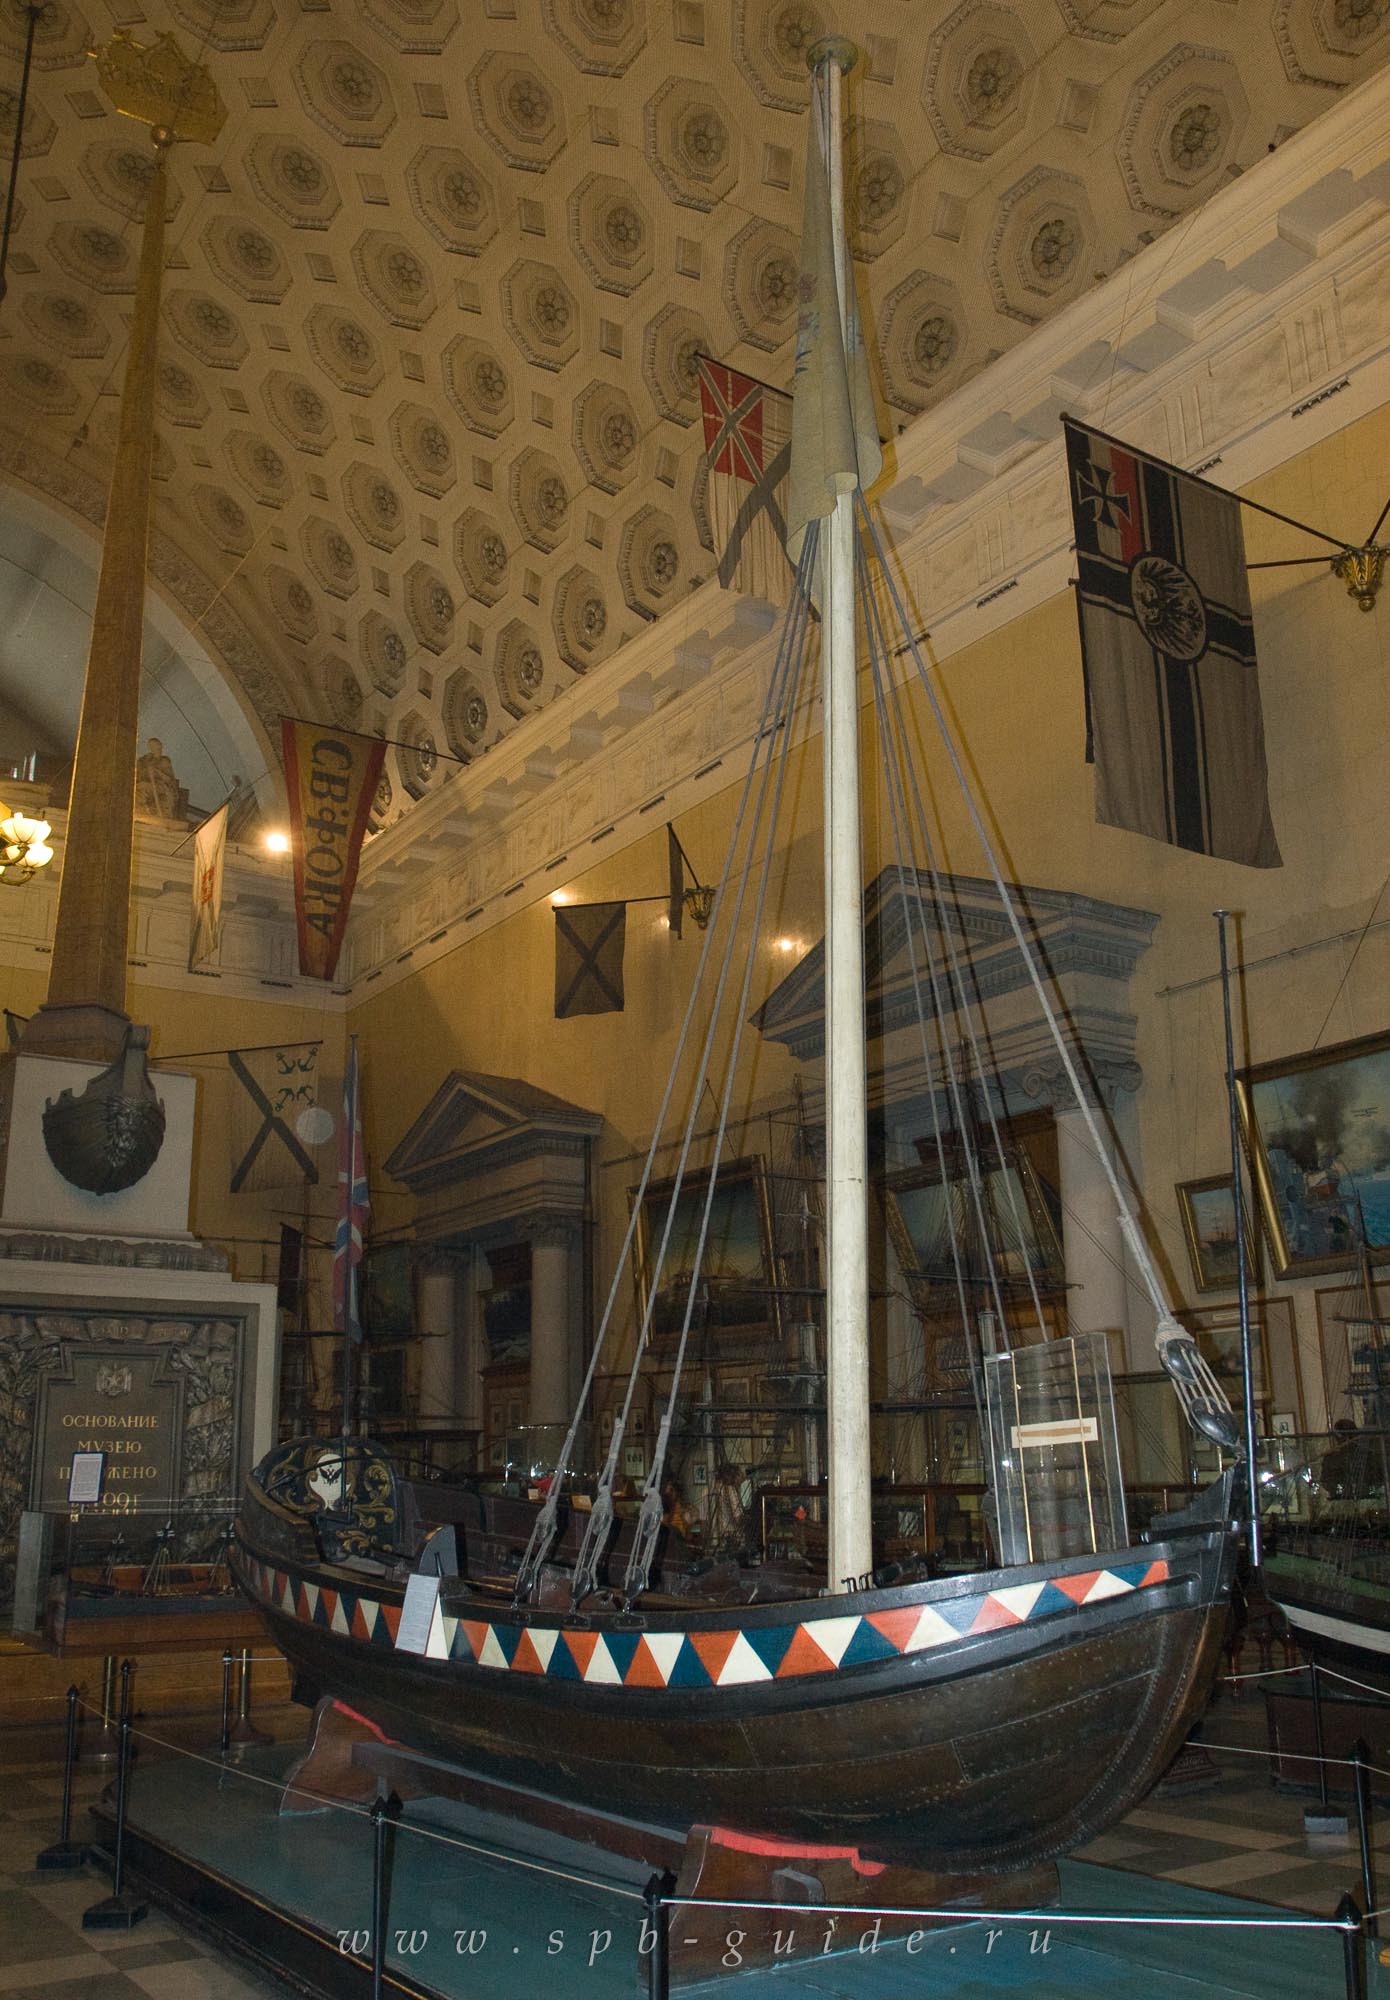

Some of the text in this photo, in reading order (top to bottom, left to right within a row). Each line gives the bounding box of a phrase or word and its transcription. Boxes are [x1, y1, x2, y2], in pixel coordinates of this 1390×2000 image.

[62, 1414, 160, 1428] ОСНОВАНИЕ
[78, 1440, 142, 1454] МУЗЕЮ
[59, 1465, 157, 1480] ПЖЕНО
